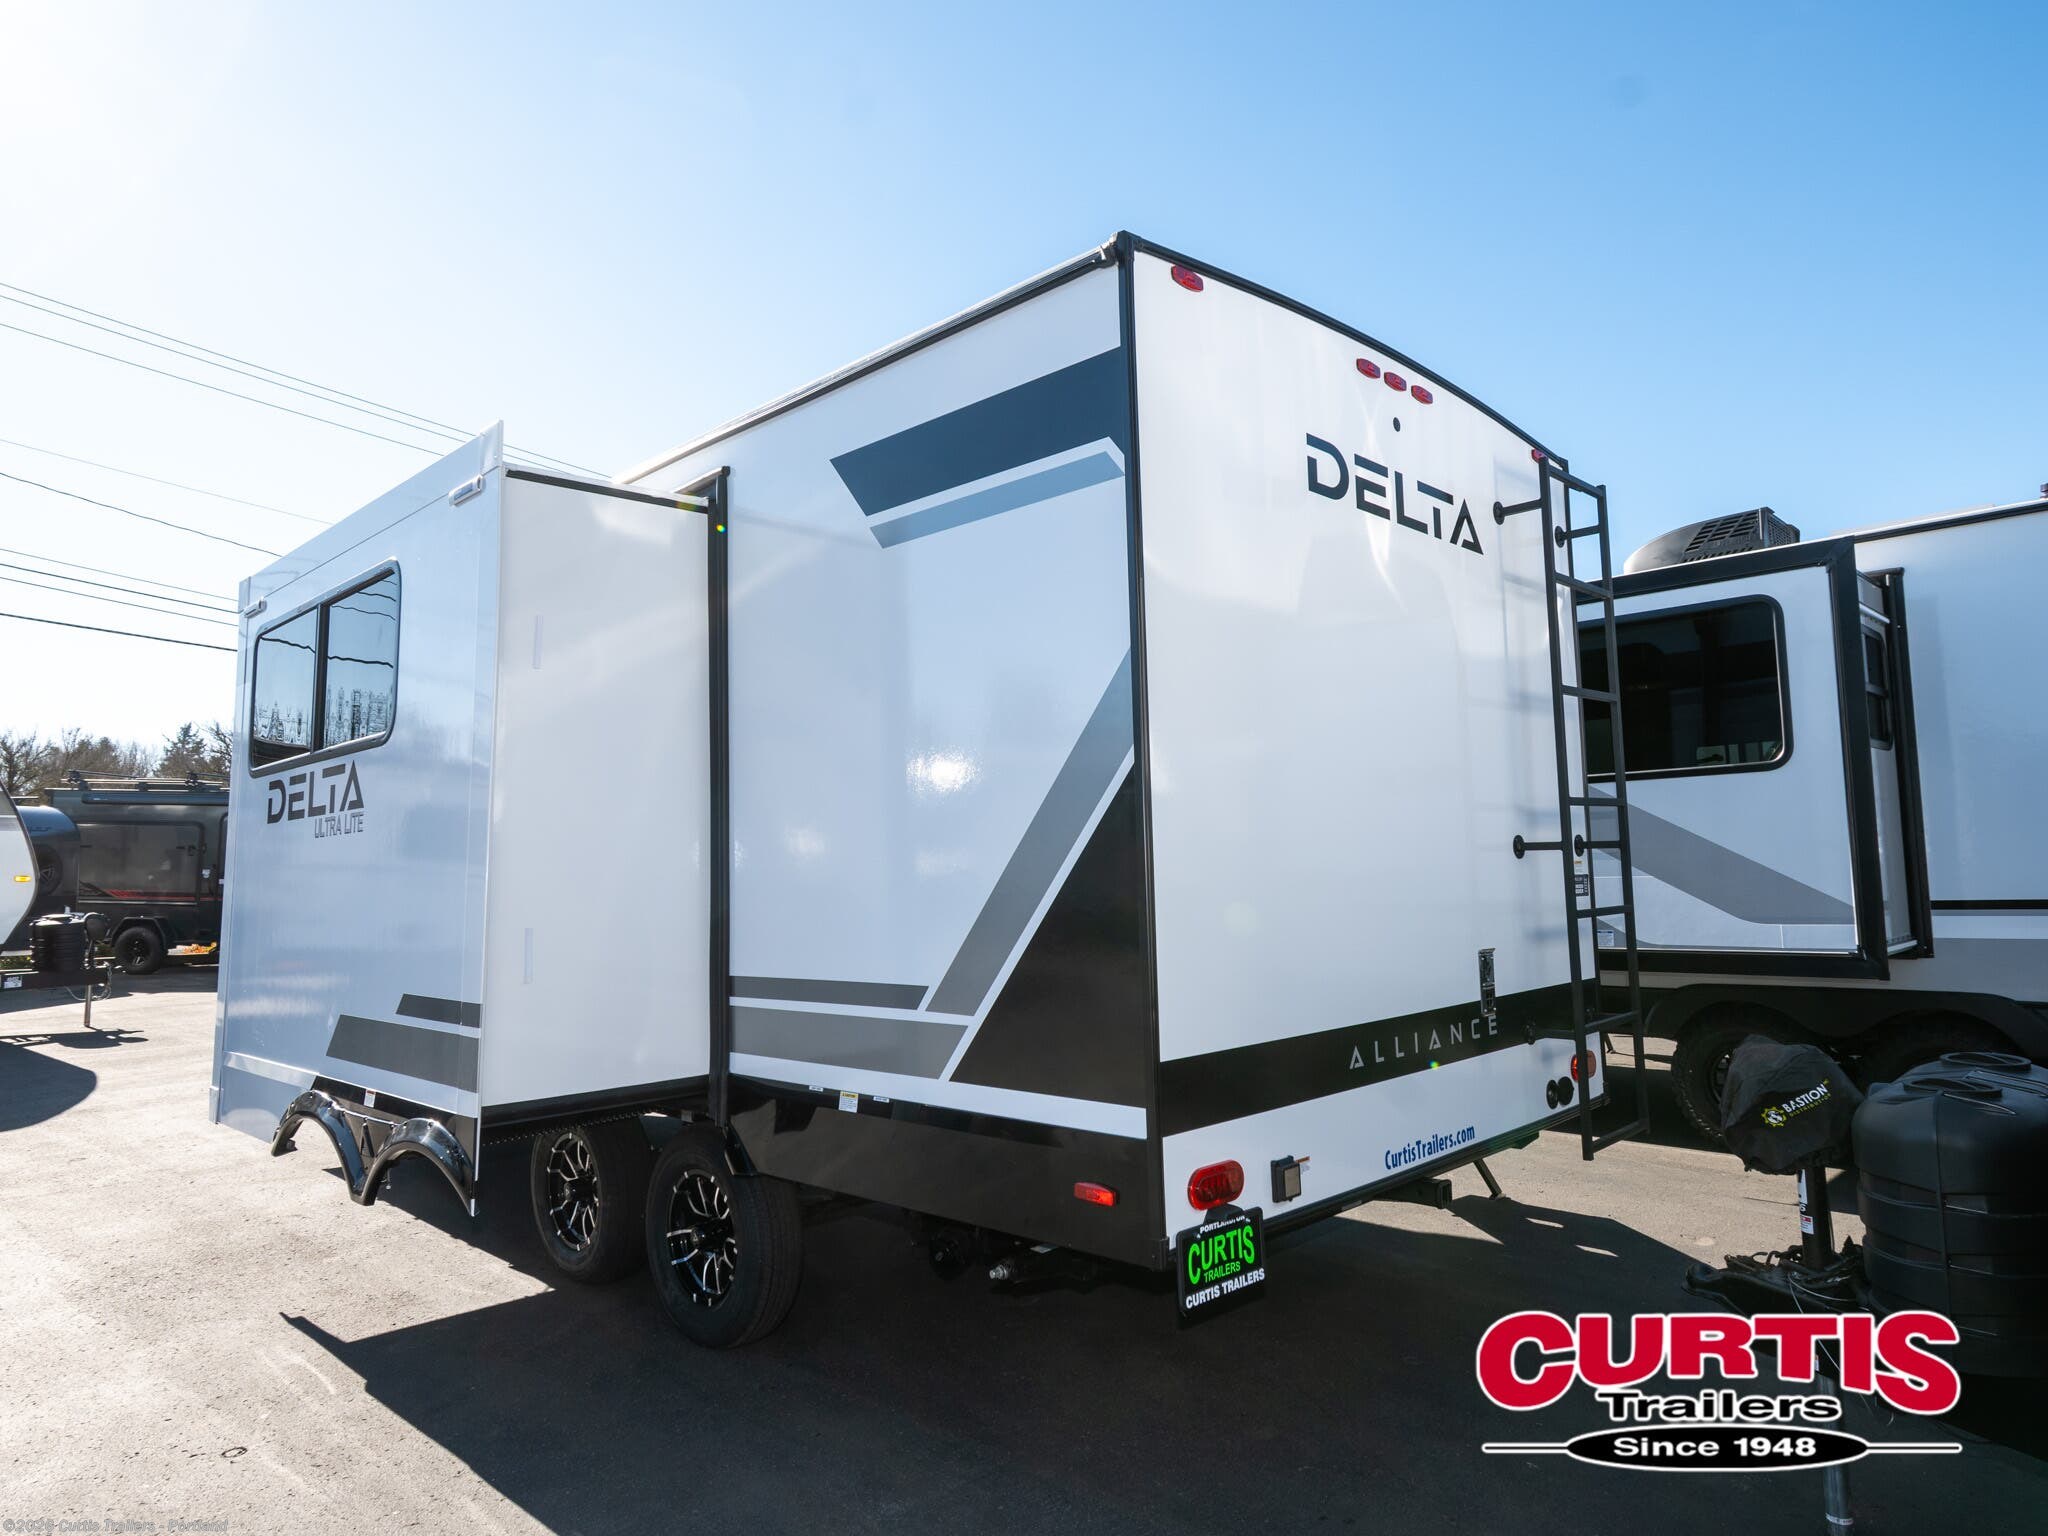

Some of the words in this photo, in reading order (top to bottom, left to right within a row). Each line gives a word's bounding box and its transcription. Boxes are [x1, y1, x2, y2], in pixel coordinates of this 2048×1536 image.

[1305, 432, 1484, 556] DELTA
[266, 759, 365, 825] DELTA
[314, 815, 342, 839] ULTRA
[344, 811, 365, 835] LITE
[1349, 1014, 1499, 1070] ALLIANCE
[1781, 1083, 1829, 1113] BASTION
[1385, 1125, 1476, 1171] CurtisTrailers.com
[1188, 1225, 1255, 1285] CURTIS
[1204, 1261, 1241, 1283] TRAILERS
[1185, 1284, 1221, 1310] CURTIS
[1222, 1267, 1265, 1295] TRAILERS
